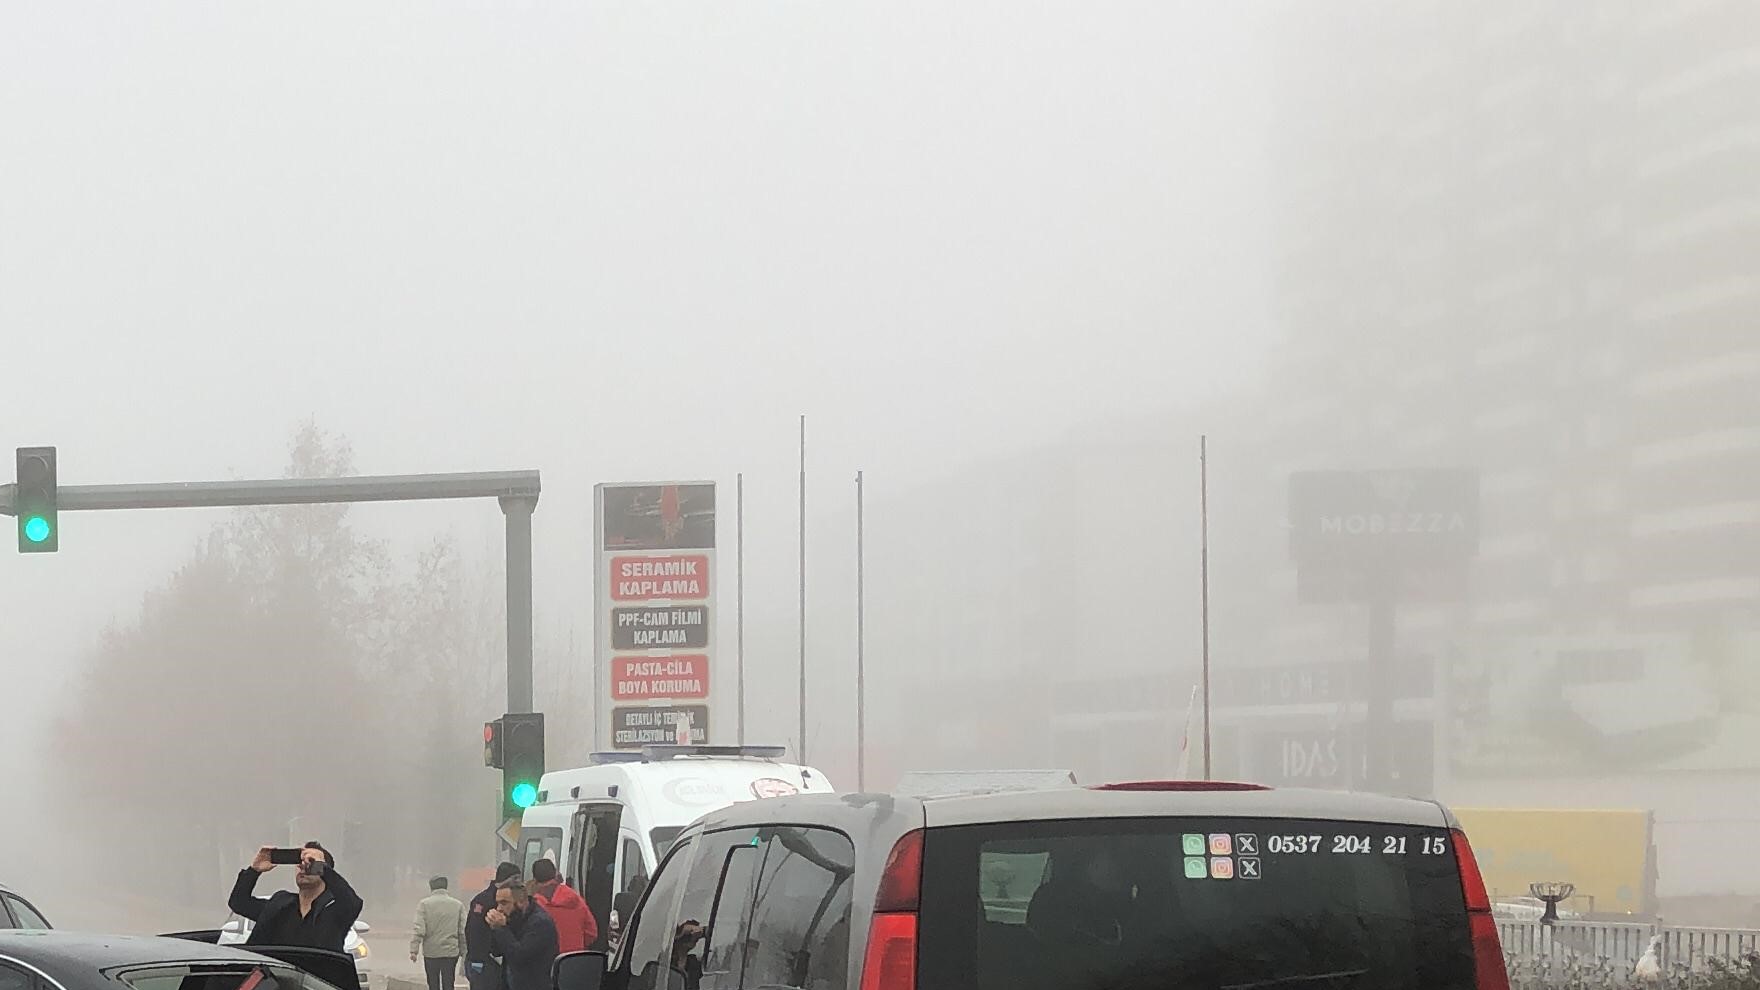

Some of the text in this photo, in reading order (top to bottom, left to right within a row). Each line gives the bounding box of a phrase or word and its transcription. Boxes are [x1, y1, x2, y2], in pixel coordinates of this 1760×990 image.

[621, 559, 697, 577] SERAMİK
[619, 580, 699, 596] KAPLAMA
[618, 608, 702, 627] PPF-CAM FİLMİ
[633, 629, 687, 645] KAPLAMA
[626, 660, 693, 676] PASTA-CİLA
[618, 679, 701, 695] BOYA KORUMA
[1267, 835, 1322, 854] 0537
[1332, 835, 1371, 854] 204
[1382, 836, 1407, 855] 21
[1422, 836, 1446, 855] 15
